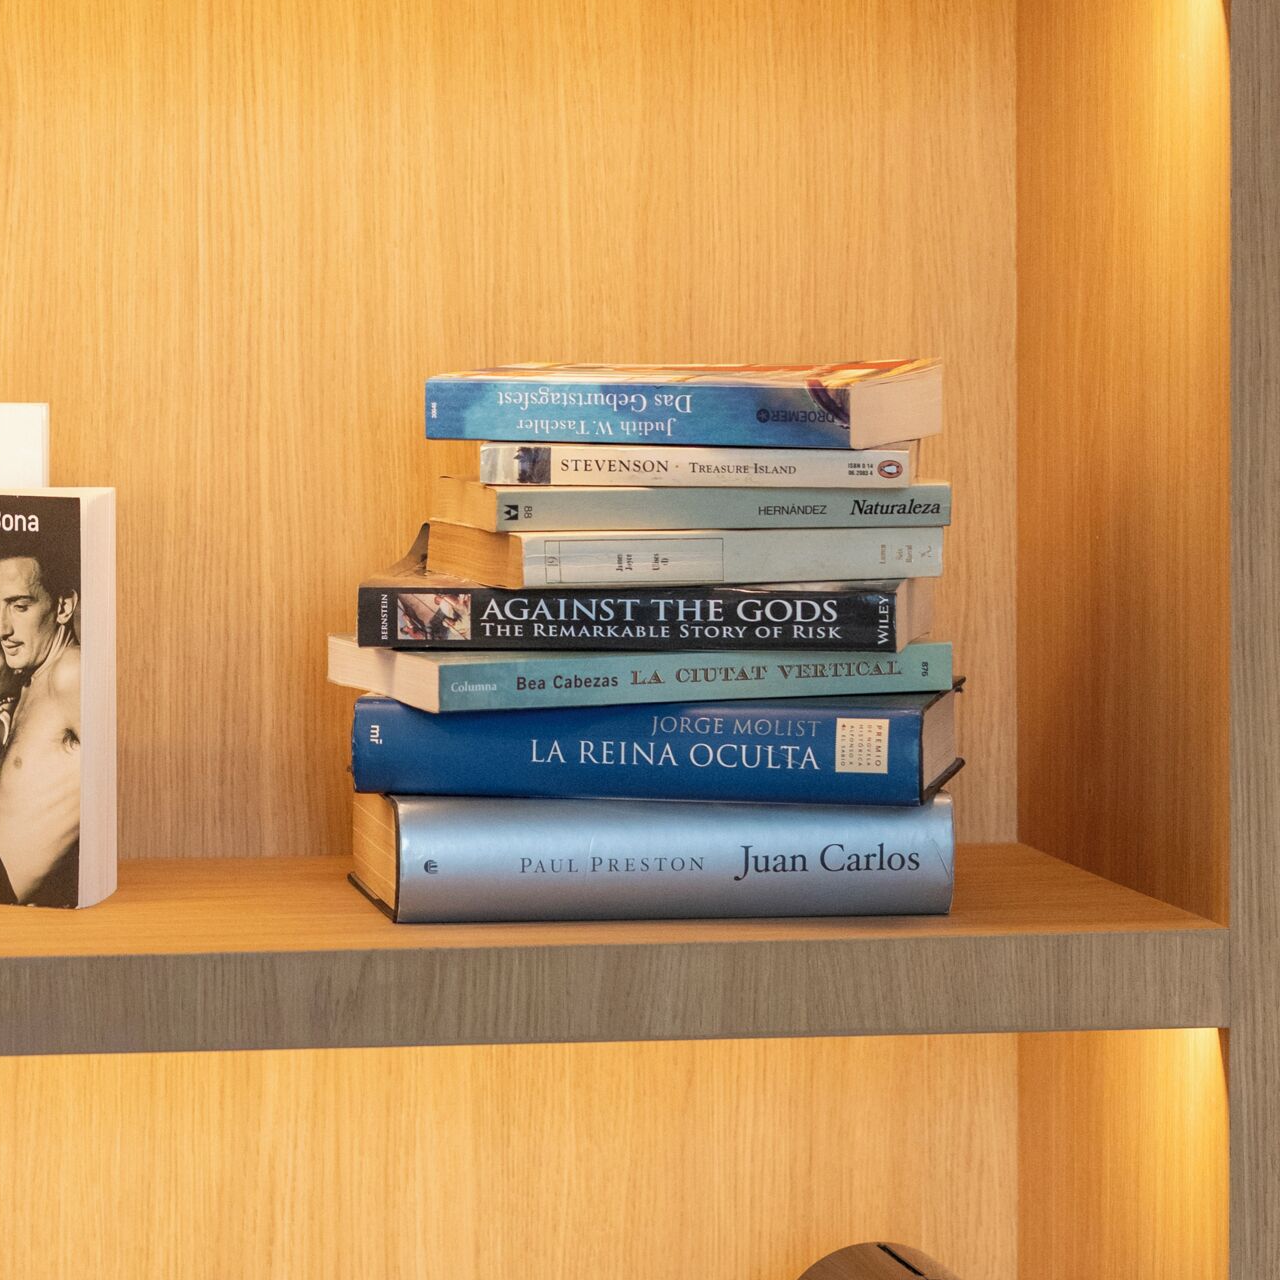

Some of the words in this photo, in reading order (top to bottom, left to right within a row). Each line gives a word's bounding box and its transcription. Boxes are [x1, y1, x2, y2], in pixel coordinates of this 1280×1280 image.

[496, 390, 648, 414] Geburtstagsfest
[654, 392, 694, 414] Das
[516, 418, 589, 436] Taschler
[769, 409, 837, 423] DROEMER
[591, 419, 615, 436] W.
[619, 418, 679, 437] Judith
[560, 458, 670, 474] STEVENSON
[523, 504, 533, 519] 88
[758, 503, 828, 516] HERNÁNDEZ
[850, 497, 941, 516] Naturaleza
[380, 593, 389, 641] BERNSTEIN
[479, 596, 638, 623] AGAINST
[651, 597, 724, 623] THE
[736, 598, 839, 624] GODS
[877, 595, 890, 645] WILEY
[480, 622, 525, 638] THE
[533, 622, 672, 639] REMARKABLE
[679, 623, 750, 639] STORY
[756, 625, 783, 639] OF
[793, 623, 843, 640] RISK
[450, 680, 498, 694] Columna
[516, 676, 546, 691] Bea
[553, 672, 619, 690] Cabezas
[630, 669, 664, 686] LA
[675, 665, 768, 684] CIUTAT
[777, 659, 903, 681] VERTICAL
[920, 661, 929, 677] 876
[651, 715, 724, 736] JORGE
[733, 717, 821, 738] MOLIST
[530, 738, 567, 765] LA
[578, 739, 679, 767] REINA
[689, 742, 822, 770] OCULTA
[874, 724, 883, 767] PREMIO
[520, 856, 580, 874] PAUL
[590, 855, 706, 874] PRESTON
[733, 844, 810, 882] Juan
[819, 841, 921, 874] Carlos
